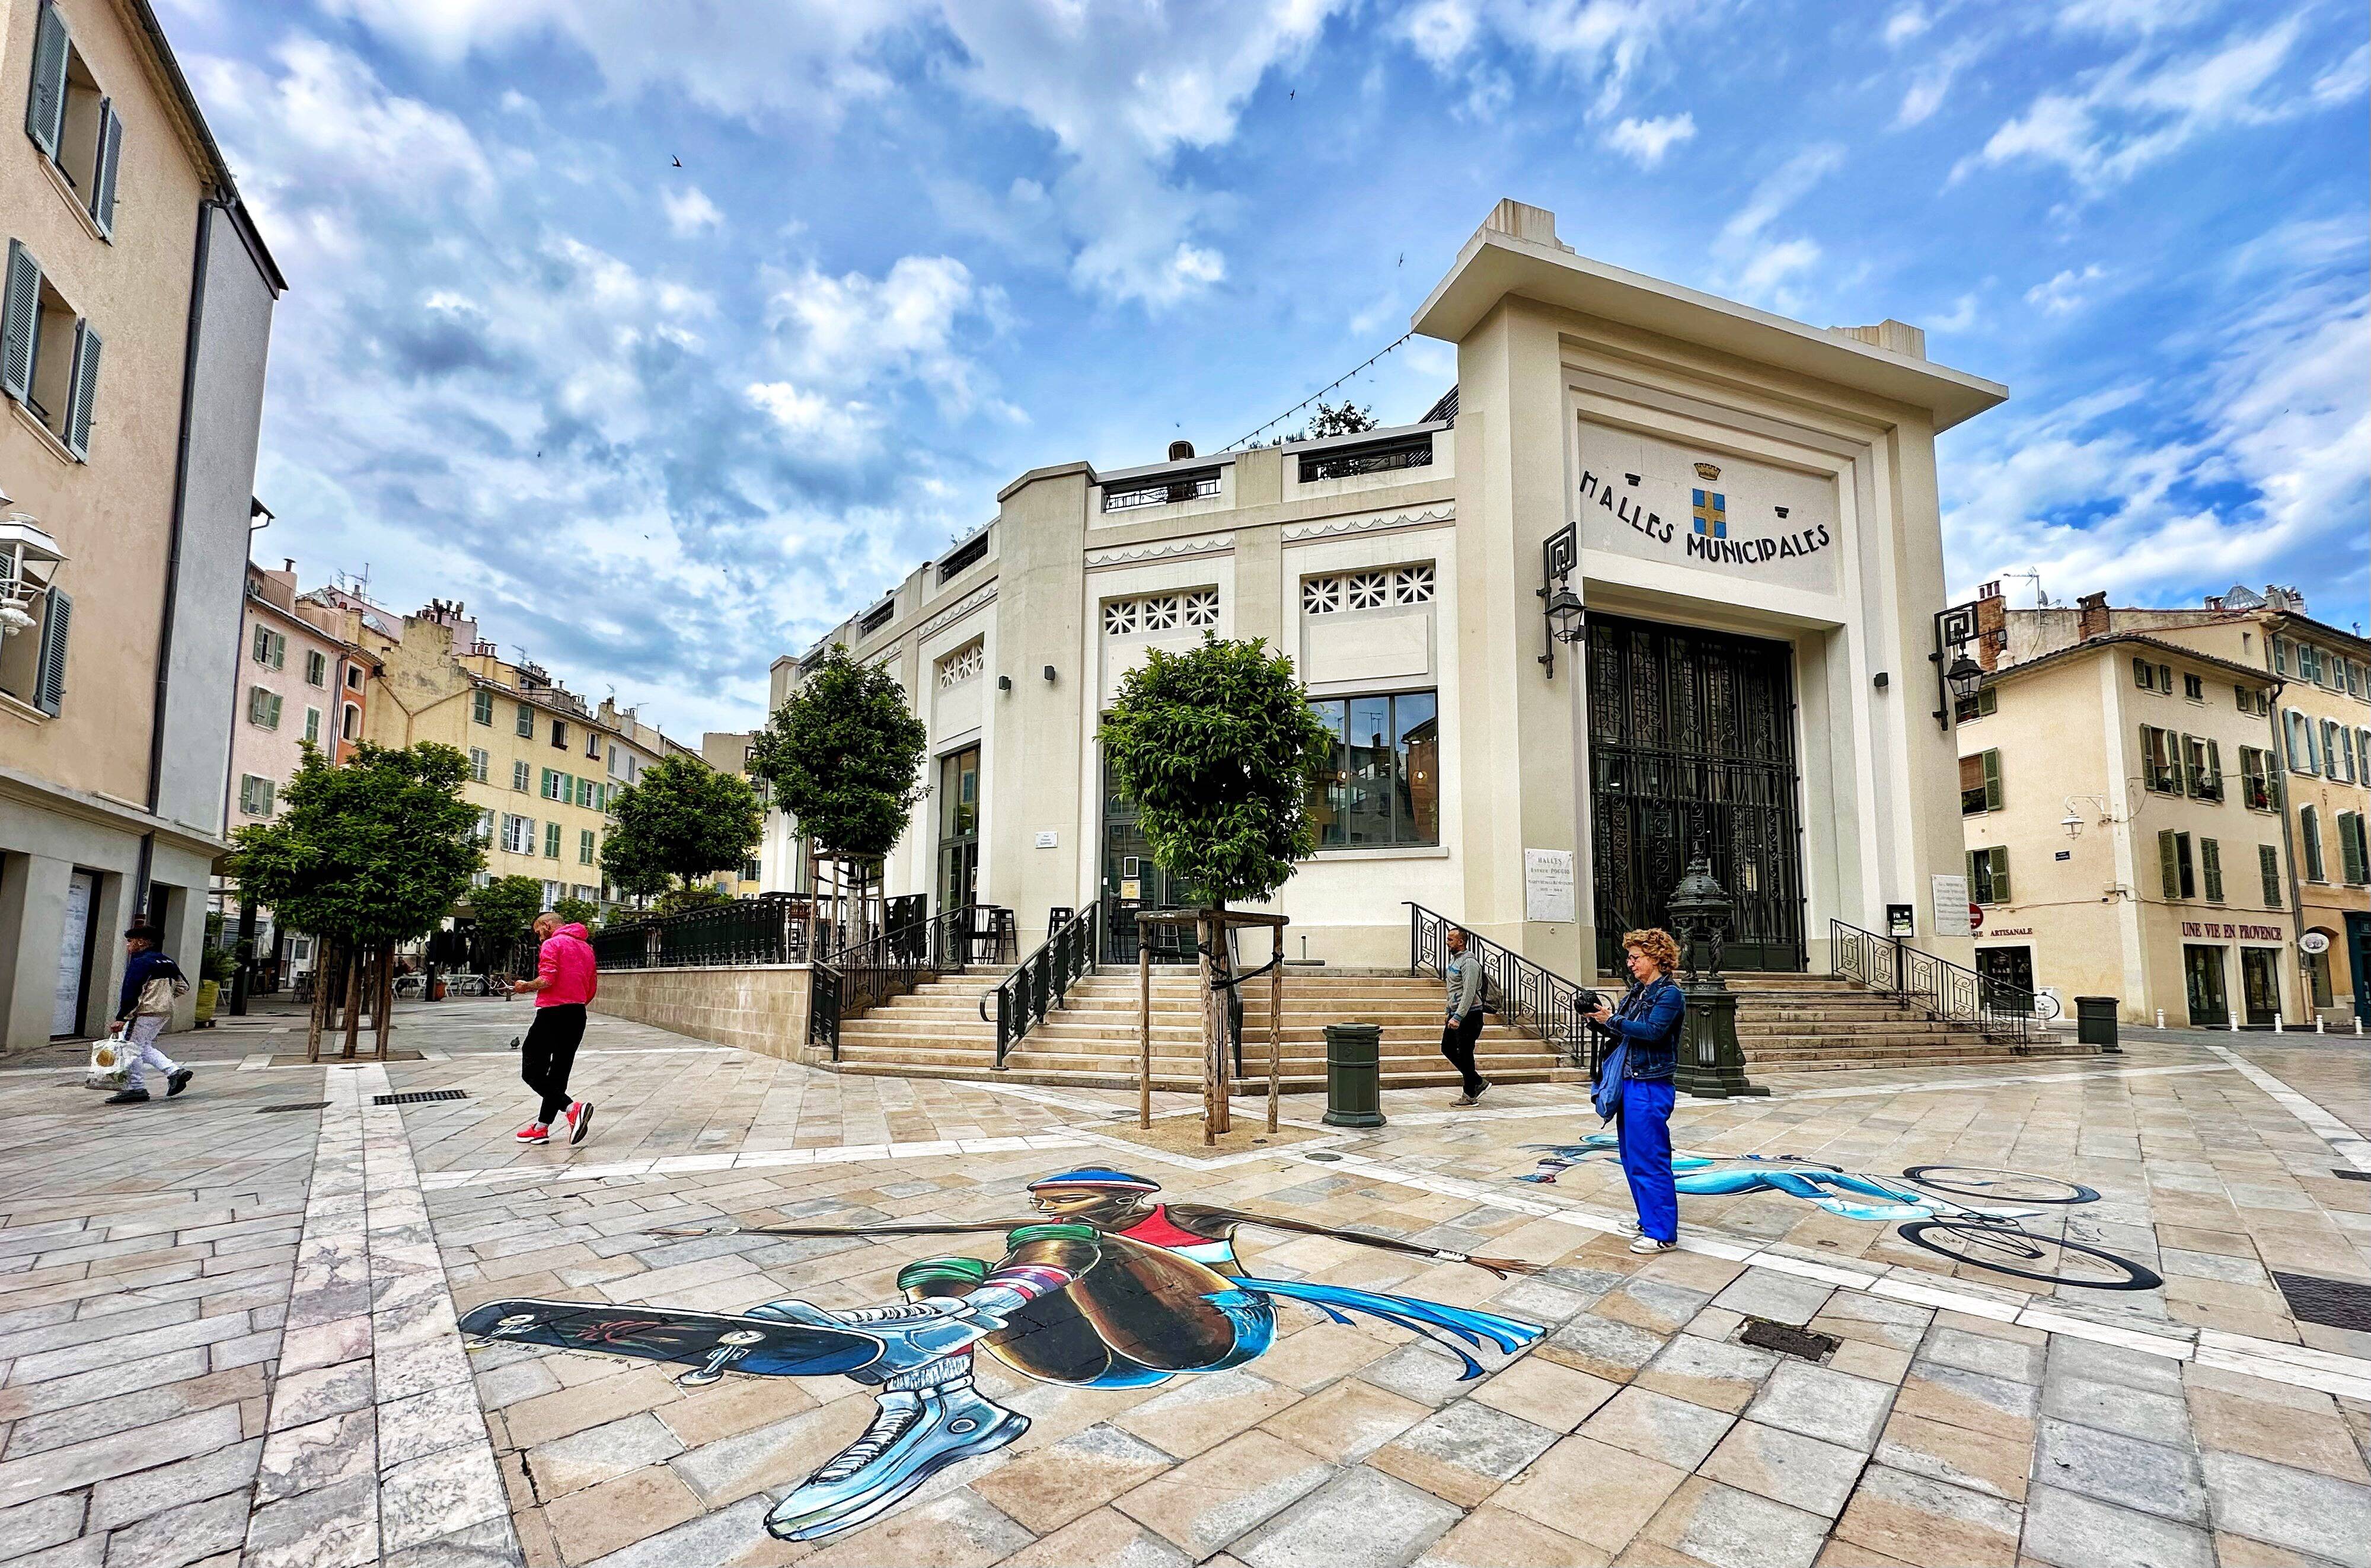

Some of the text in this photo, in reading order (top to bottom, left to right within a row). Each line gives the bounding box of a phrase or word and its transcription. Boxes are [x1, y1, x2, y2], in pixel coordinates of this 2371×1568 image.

[1579, 470, 1830, 564] HALLES MUNICIPALES
[1990, 928, 2033, 936] ARTISANALE
[2182, 922, 2282, 941] UNE VIE EN PROVENCE
